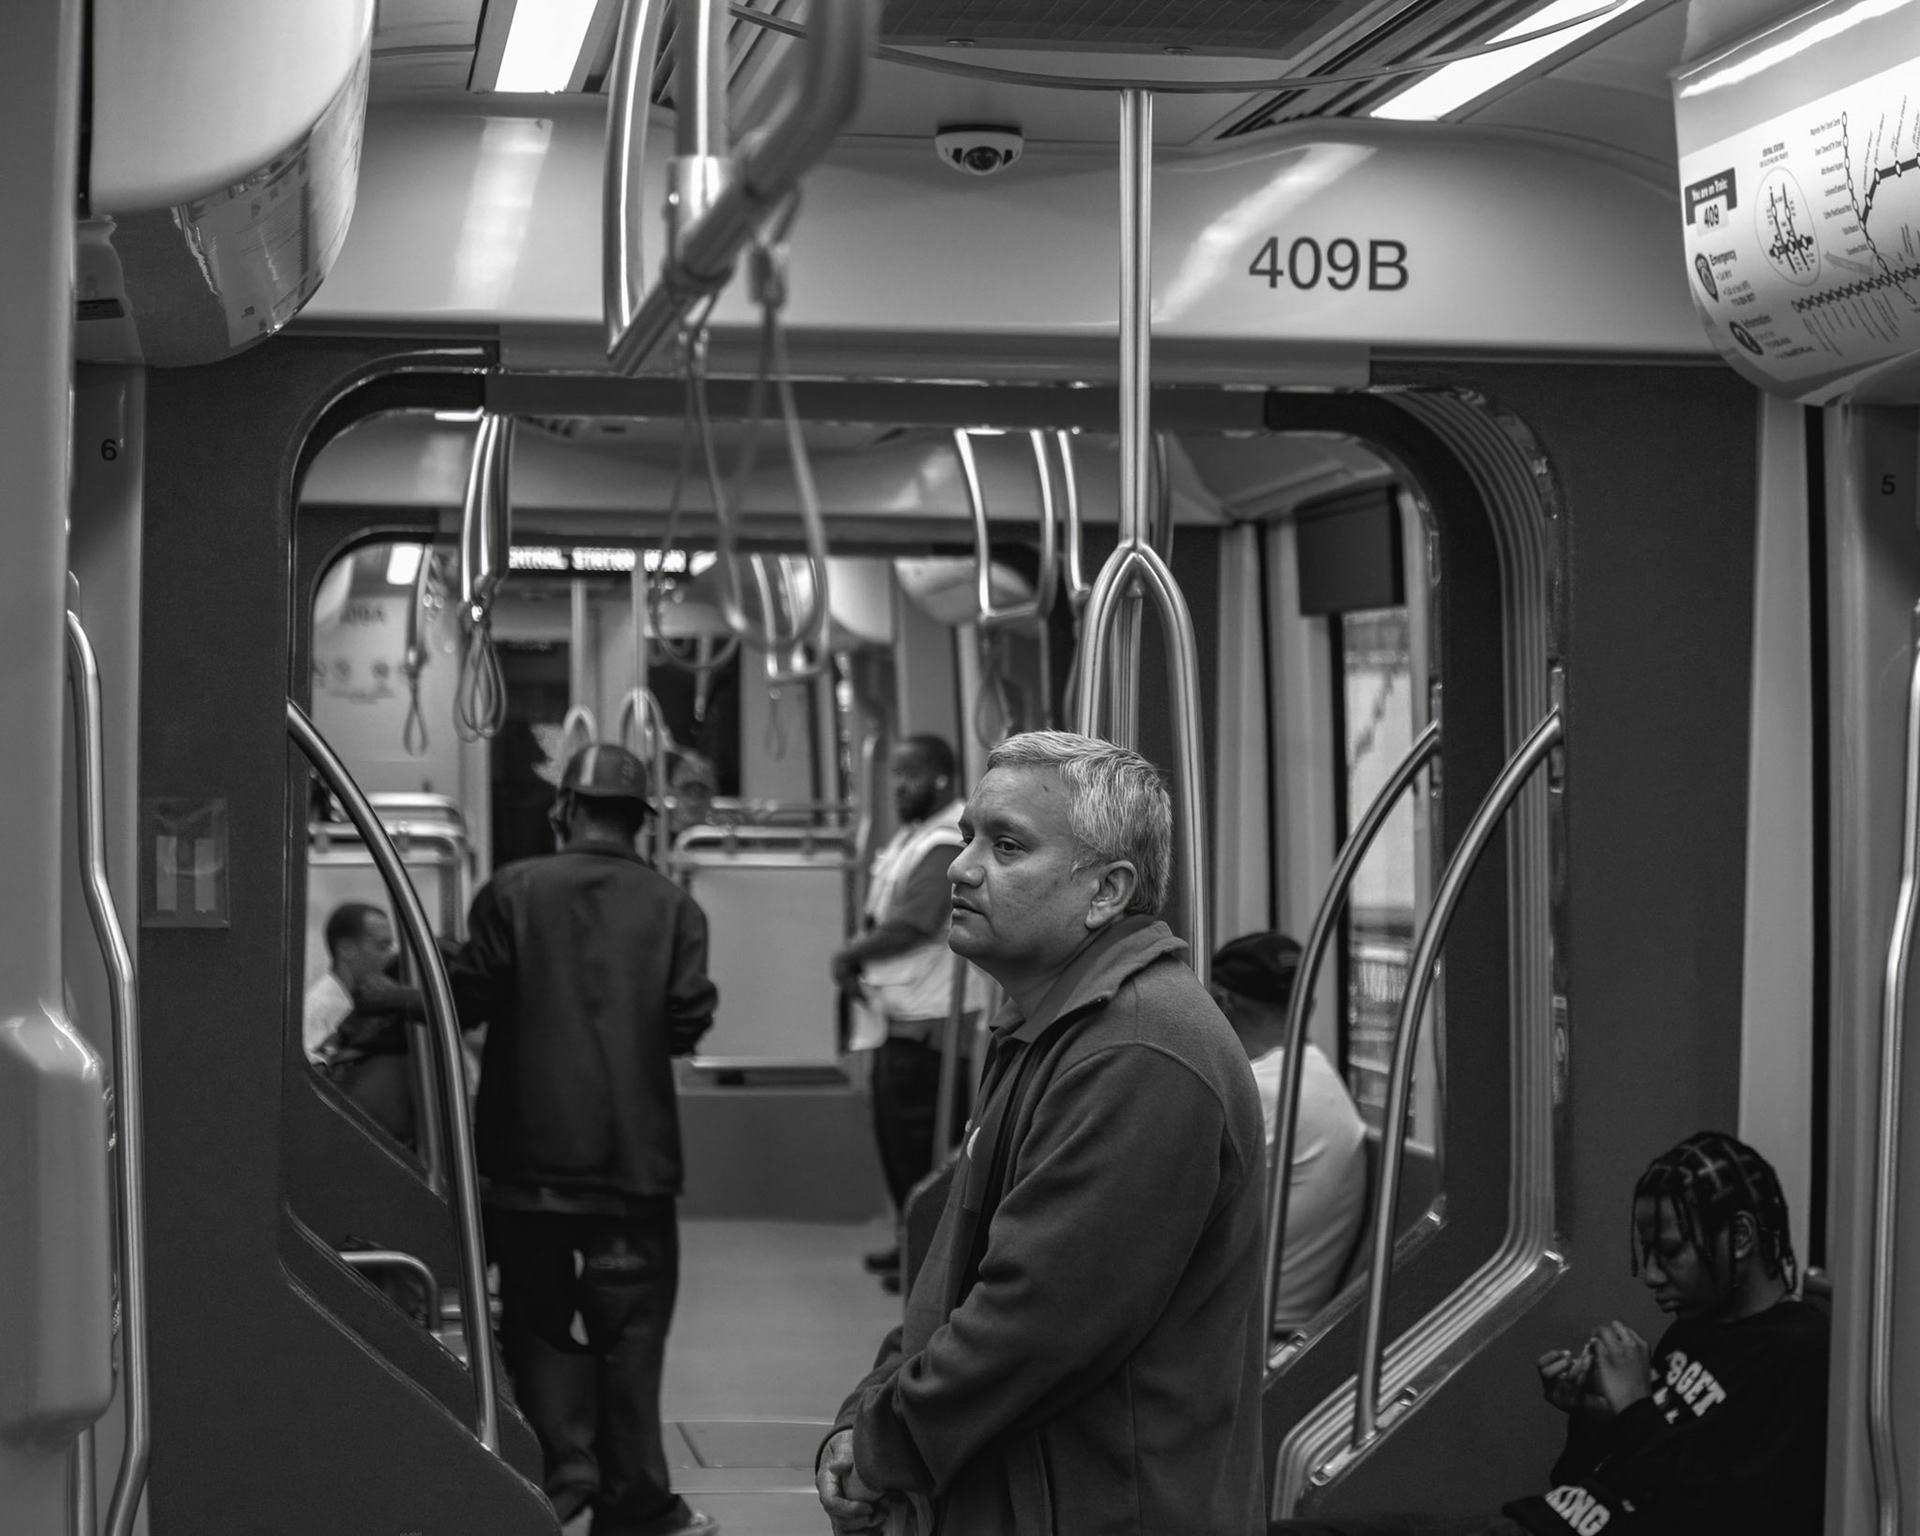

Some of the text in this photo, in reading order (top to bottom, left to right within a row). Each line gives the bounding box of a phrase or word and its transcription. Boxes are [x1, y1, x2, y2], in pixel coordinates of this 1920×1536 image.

[1704, 204, 1719, 228] 409
[1249, 236, 1409, 291] 409B
[1709, 250, 1737, 266] Emergency
[101, 438, 118, 462] 6
[1881, 474, 1897, 495] 5
